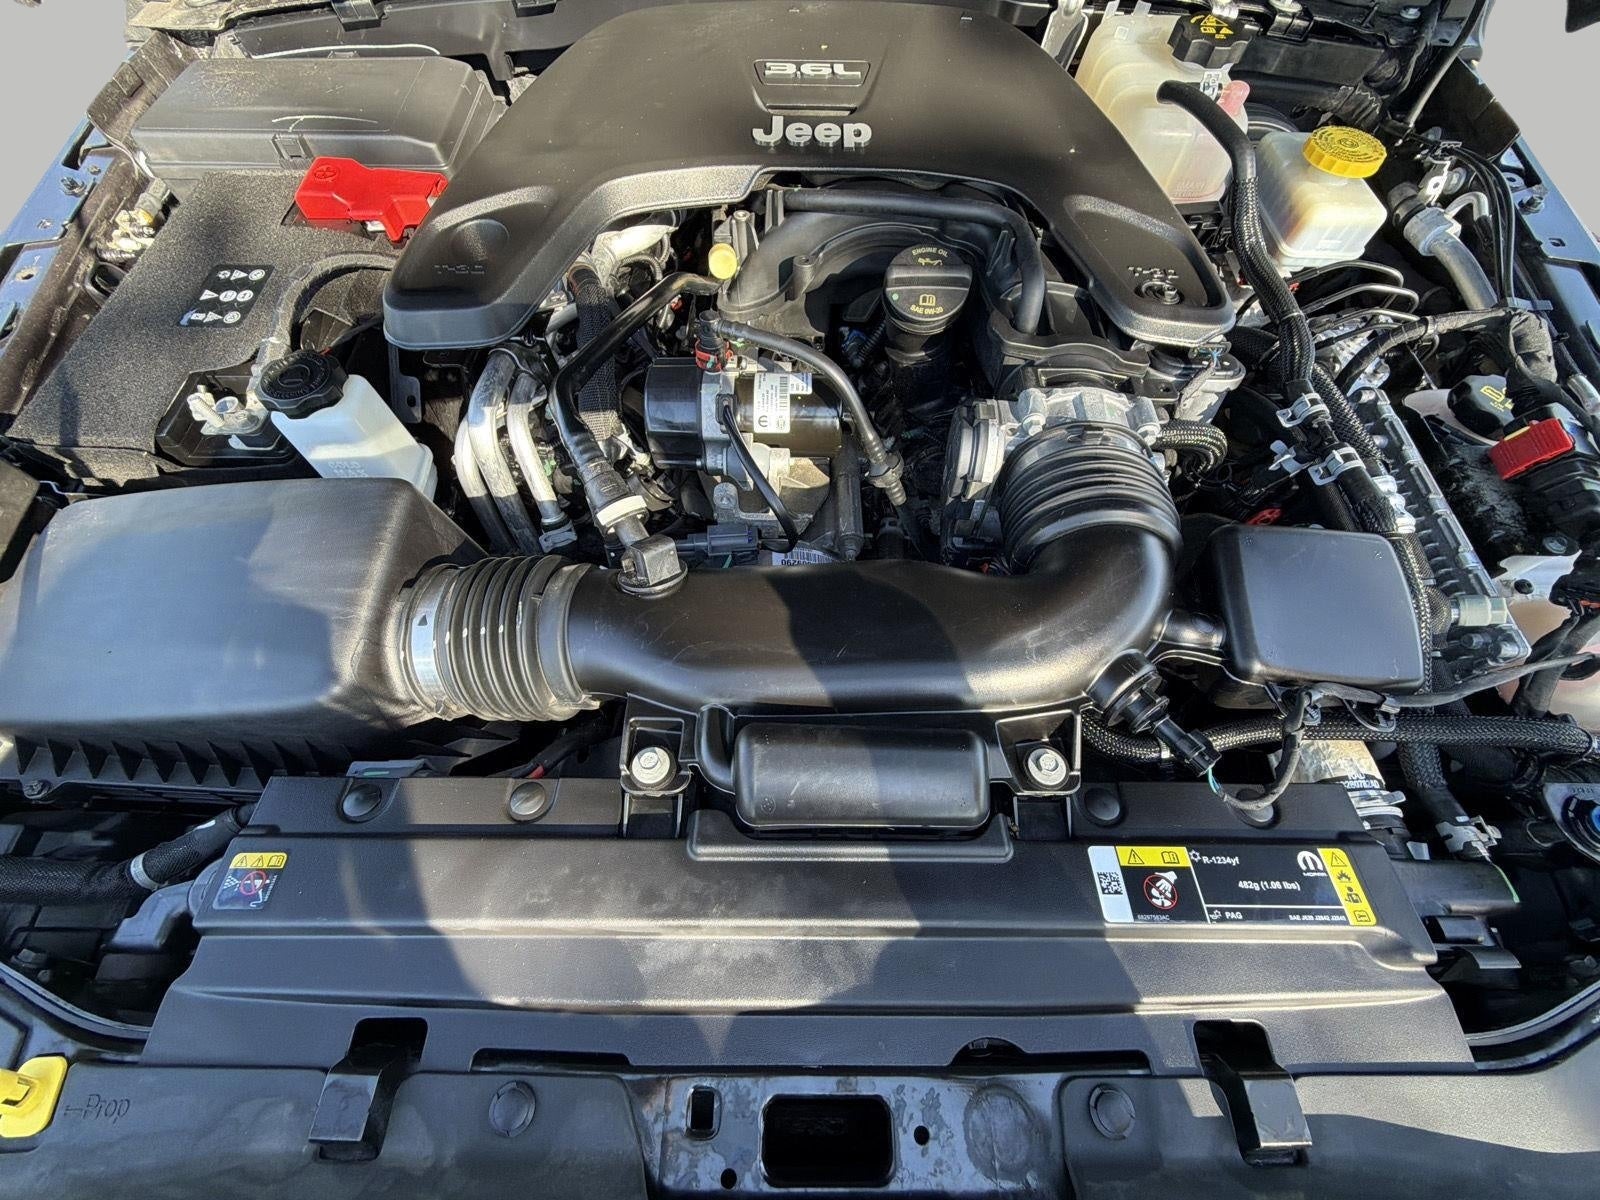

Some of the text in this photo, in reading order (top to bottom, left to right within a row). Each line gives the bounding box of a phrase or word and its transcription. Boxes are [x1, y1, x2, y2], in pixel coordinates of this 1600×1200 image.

[764, 62, 861, 79] 3.6L
[752, 115, 872, 150] Jeep
[912, 247, 948, 257] ENGINE OIL
[910, 304, 924, 314] SAE
[1202, 856, 1240, 866] R-1234yf
[1238, 880, 1301, 892] 482g (1.06 lbs)
[1225, 911, 1243, 920] PAG
[83, 1093, 131, 1125] Prop
